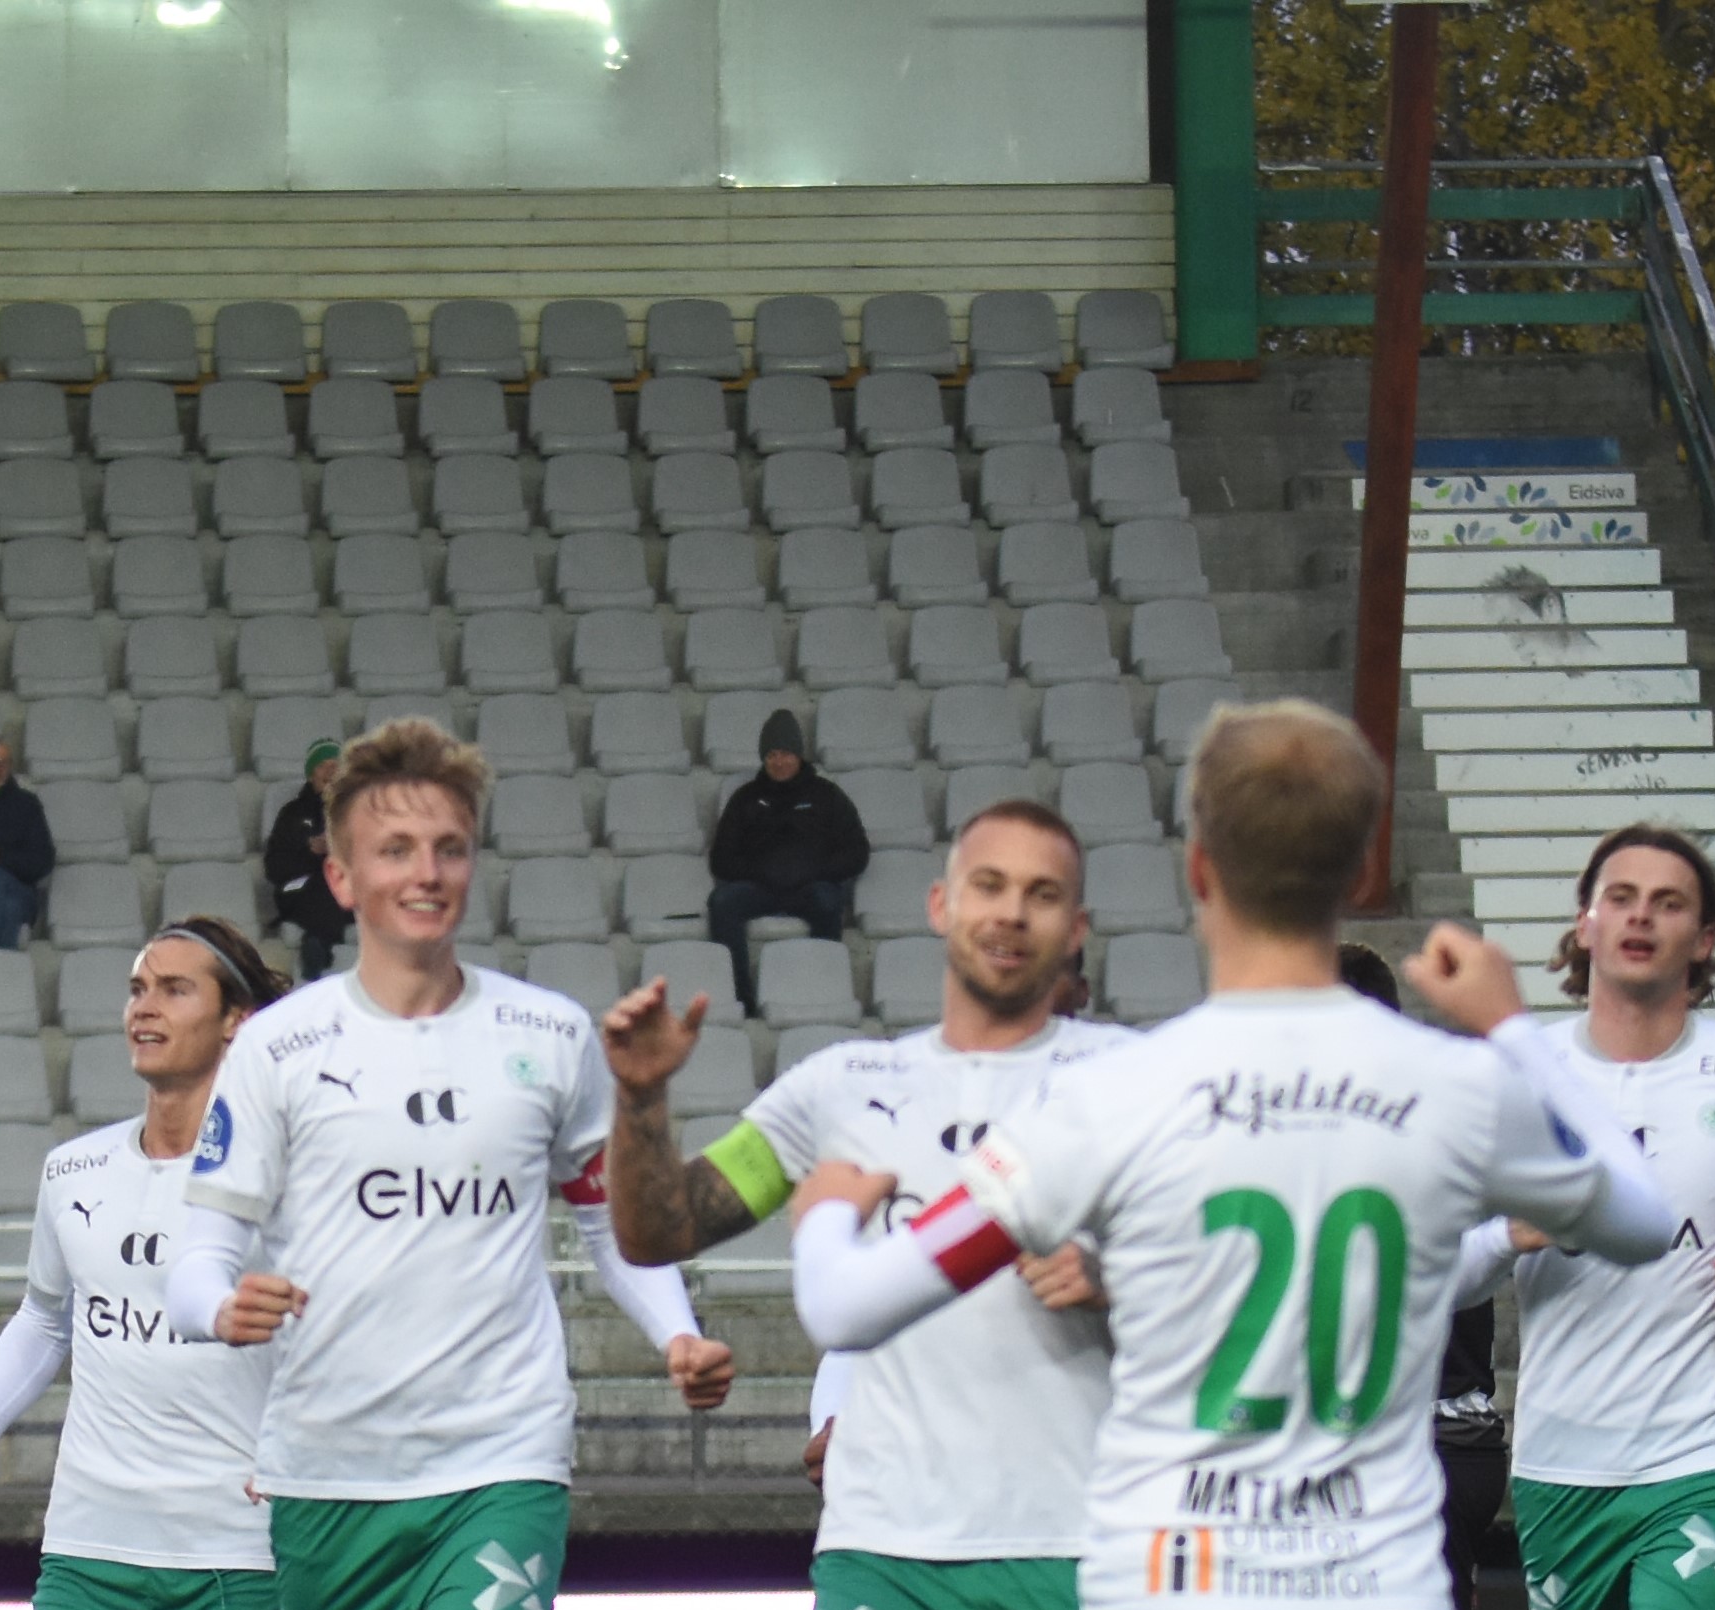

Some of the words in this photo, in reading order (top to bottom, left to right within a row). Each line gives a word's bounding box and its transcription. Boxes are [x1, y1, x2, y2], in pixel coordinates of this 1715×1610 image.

[1568, 484, 1626, 501] Eidsiva
[495, 1003, 577, 1040] Eidsiva
[268, 1020, 344, 1063] Eidsiva
[45, 1153, 110, 1182] Eidsiva
[1195, 1187, 1408, 1437] 20
